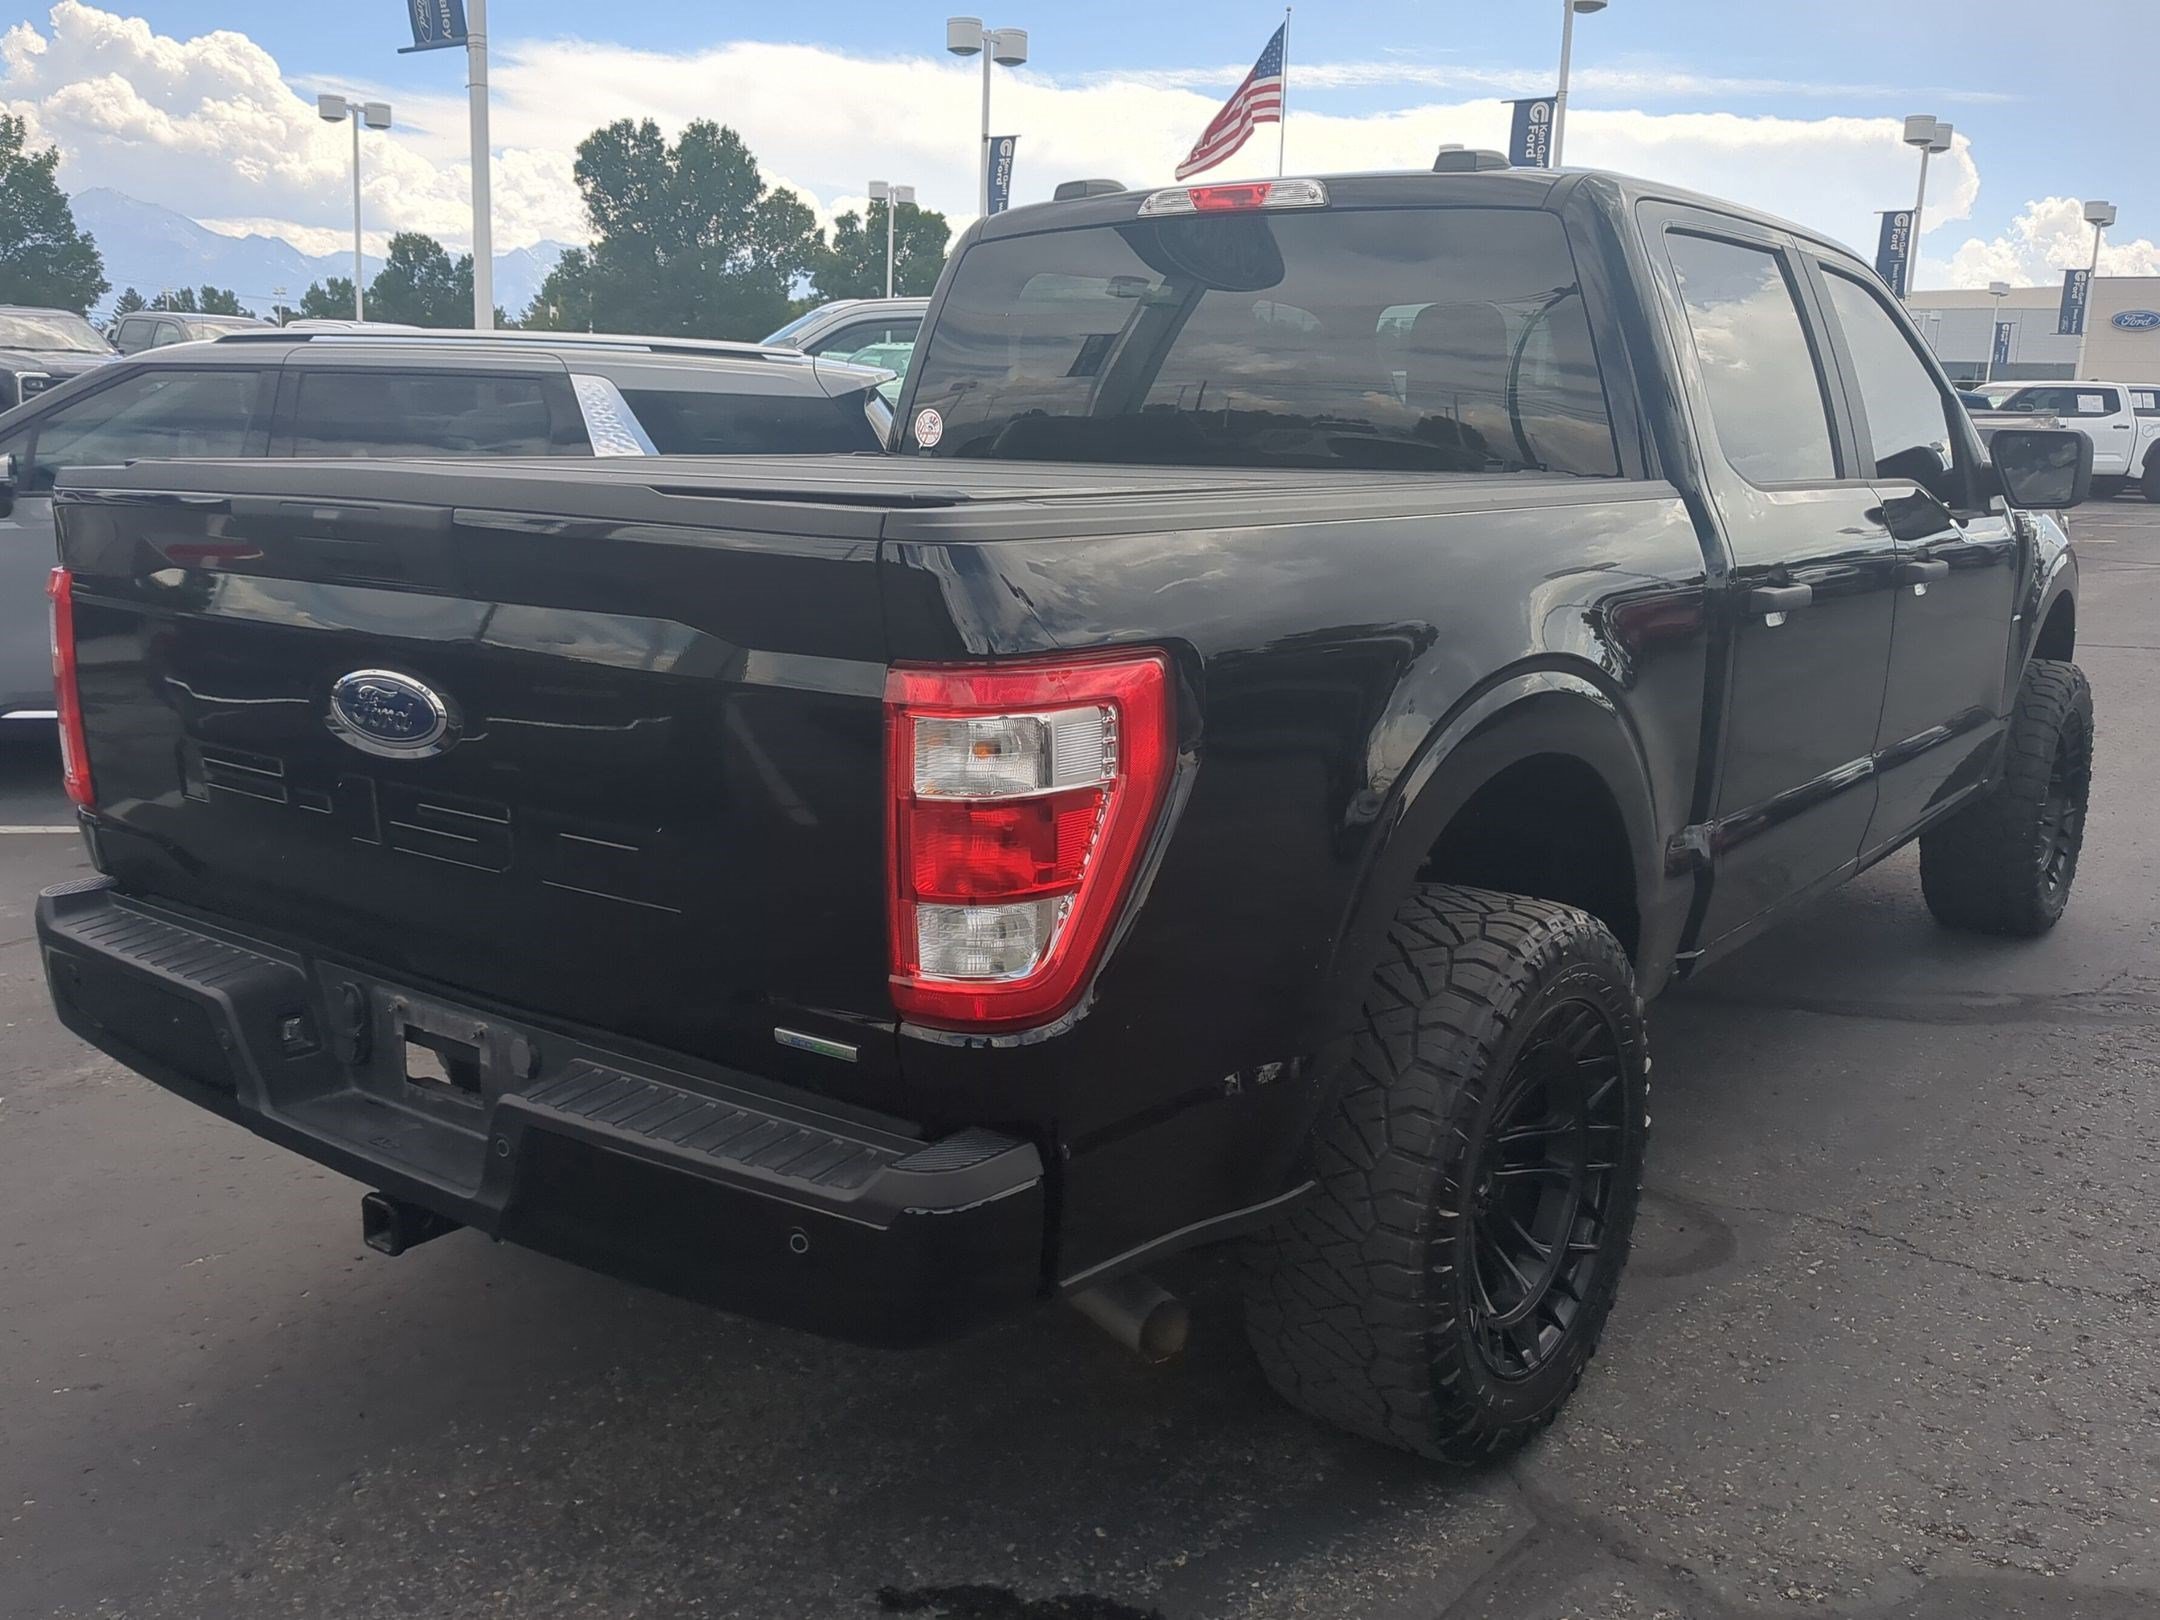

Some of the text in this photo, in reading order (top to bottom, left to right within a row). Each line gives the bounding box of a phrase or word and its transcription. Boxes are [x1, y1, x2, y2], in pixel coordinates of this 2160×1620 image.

[1525, 125, 1539, 158] Ford
[1538, 124, 1549, 144] Ken
[996, 158, 1005, 186] Ford
[1003, 158, 1011, 174] Ken
[1890, 228, 1901, 250] Ford
[2121, 313, 2152, 327] Ford
[352, 685, 414, 732] Ford
